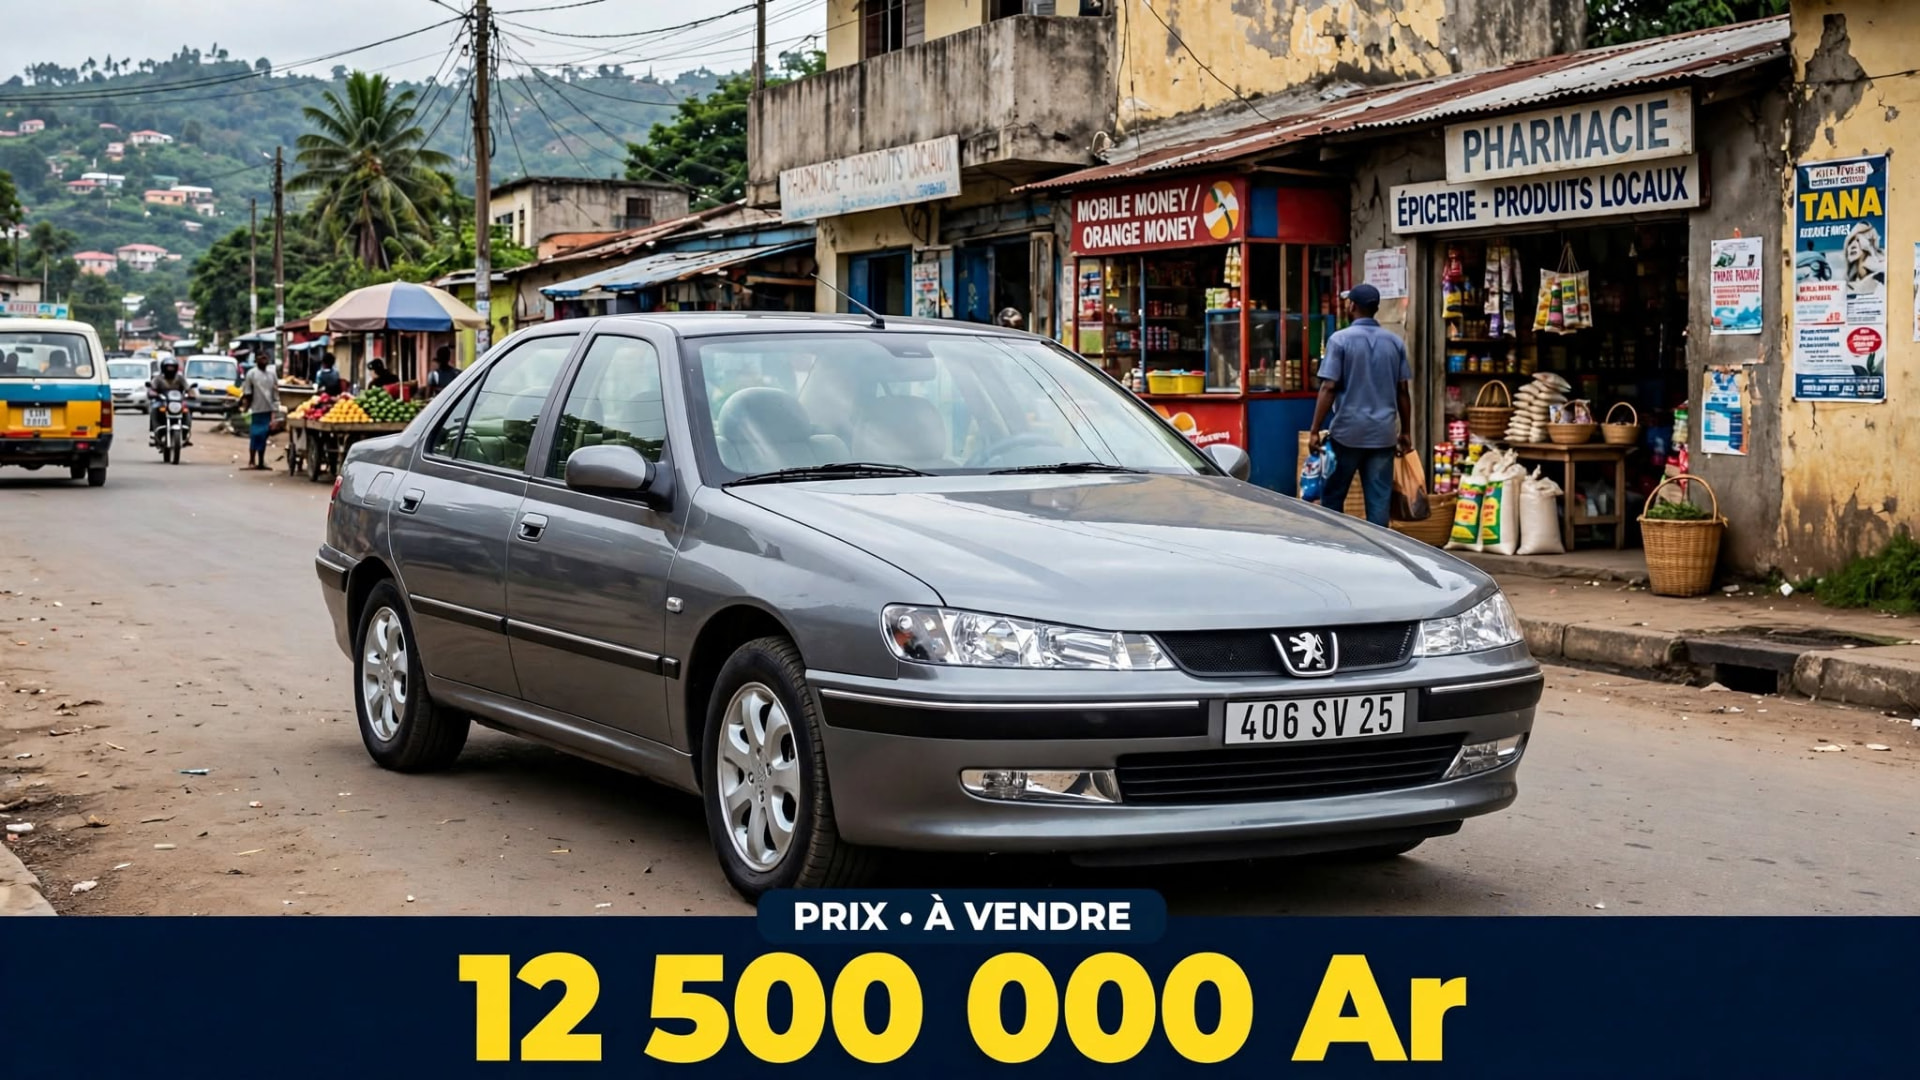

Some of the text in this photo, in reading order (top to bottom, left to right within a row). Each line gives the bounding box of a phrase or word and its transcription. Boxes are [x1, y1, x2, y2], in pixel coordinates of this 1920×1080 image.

[1463, 99, 1670, 174] PHARMACIE
[1077, 195, 1131, 223] MOBILE
[1135, 187, 1189, 216] MONEY
[1398, 189, 1477, 227] ÉPICERIE
[1494, 176, 1594, 218] PRODUITS
[1600, 166, 1689, 208] LOCAUX
[1799, 186, 1883, 222] TANA
[1083, 215, 1198, 250] ORANGE MONEY
[1240, 696, 1393, 741] 406 SV 25
